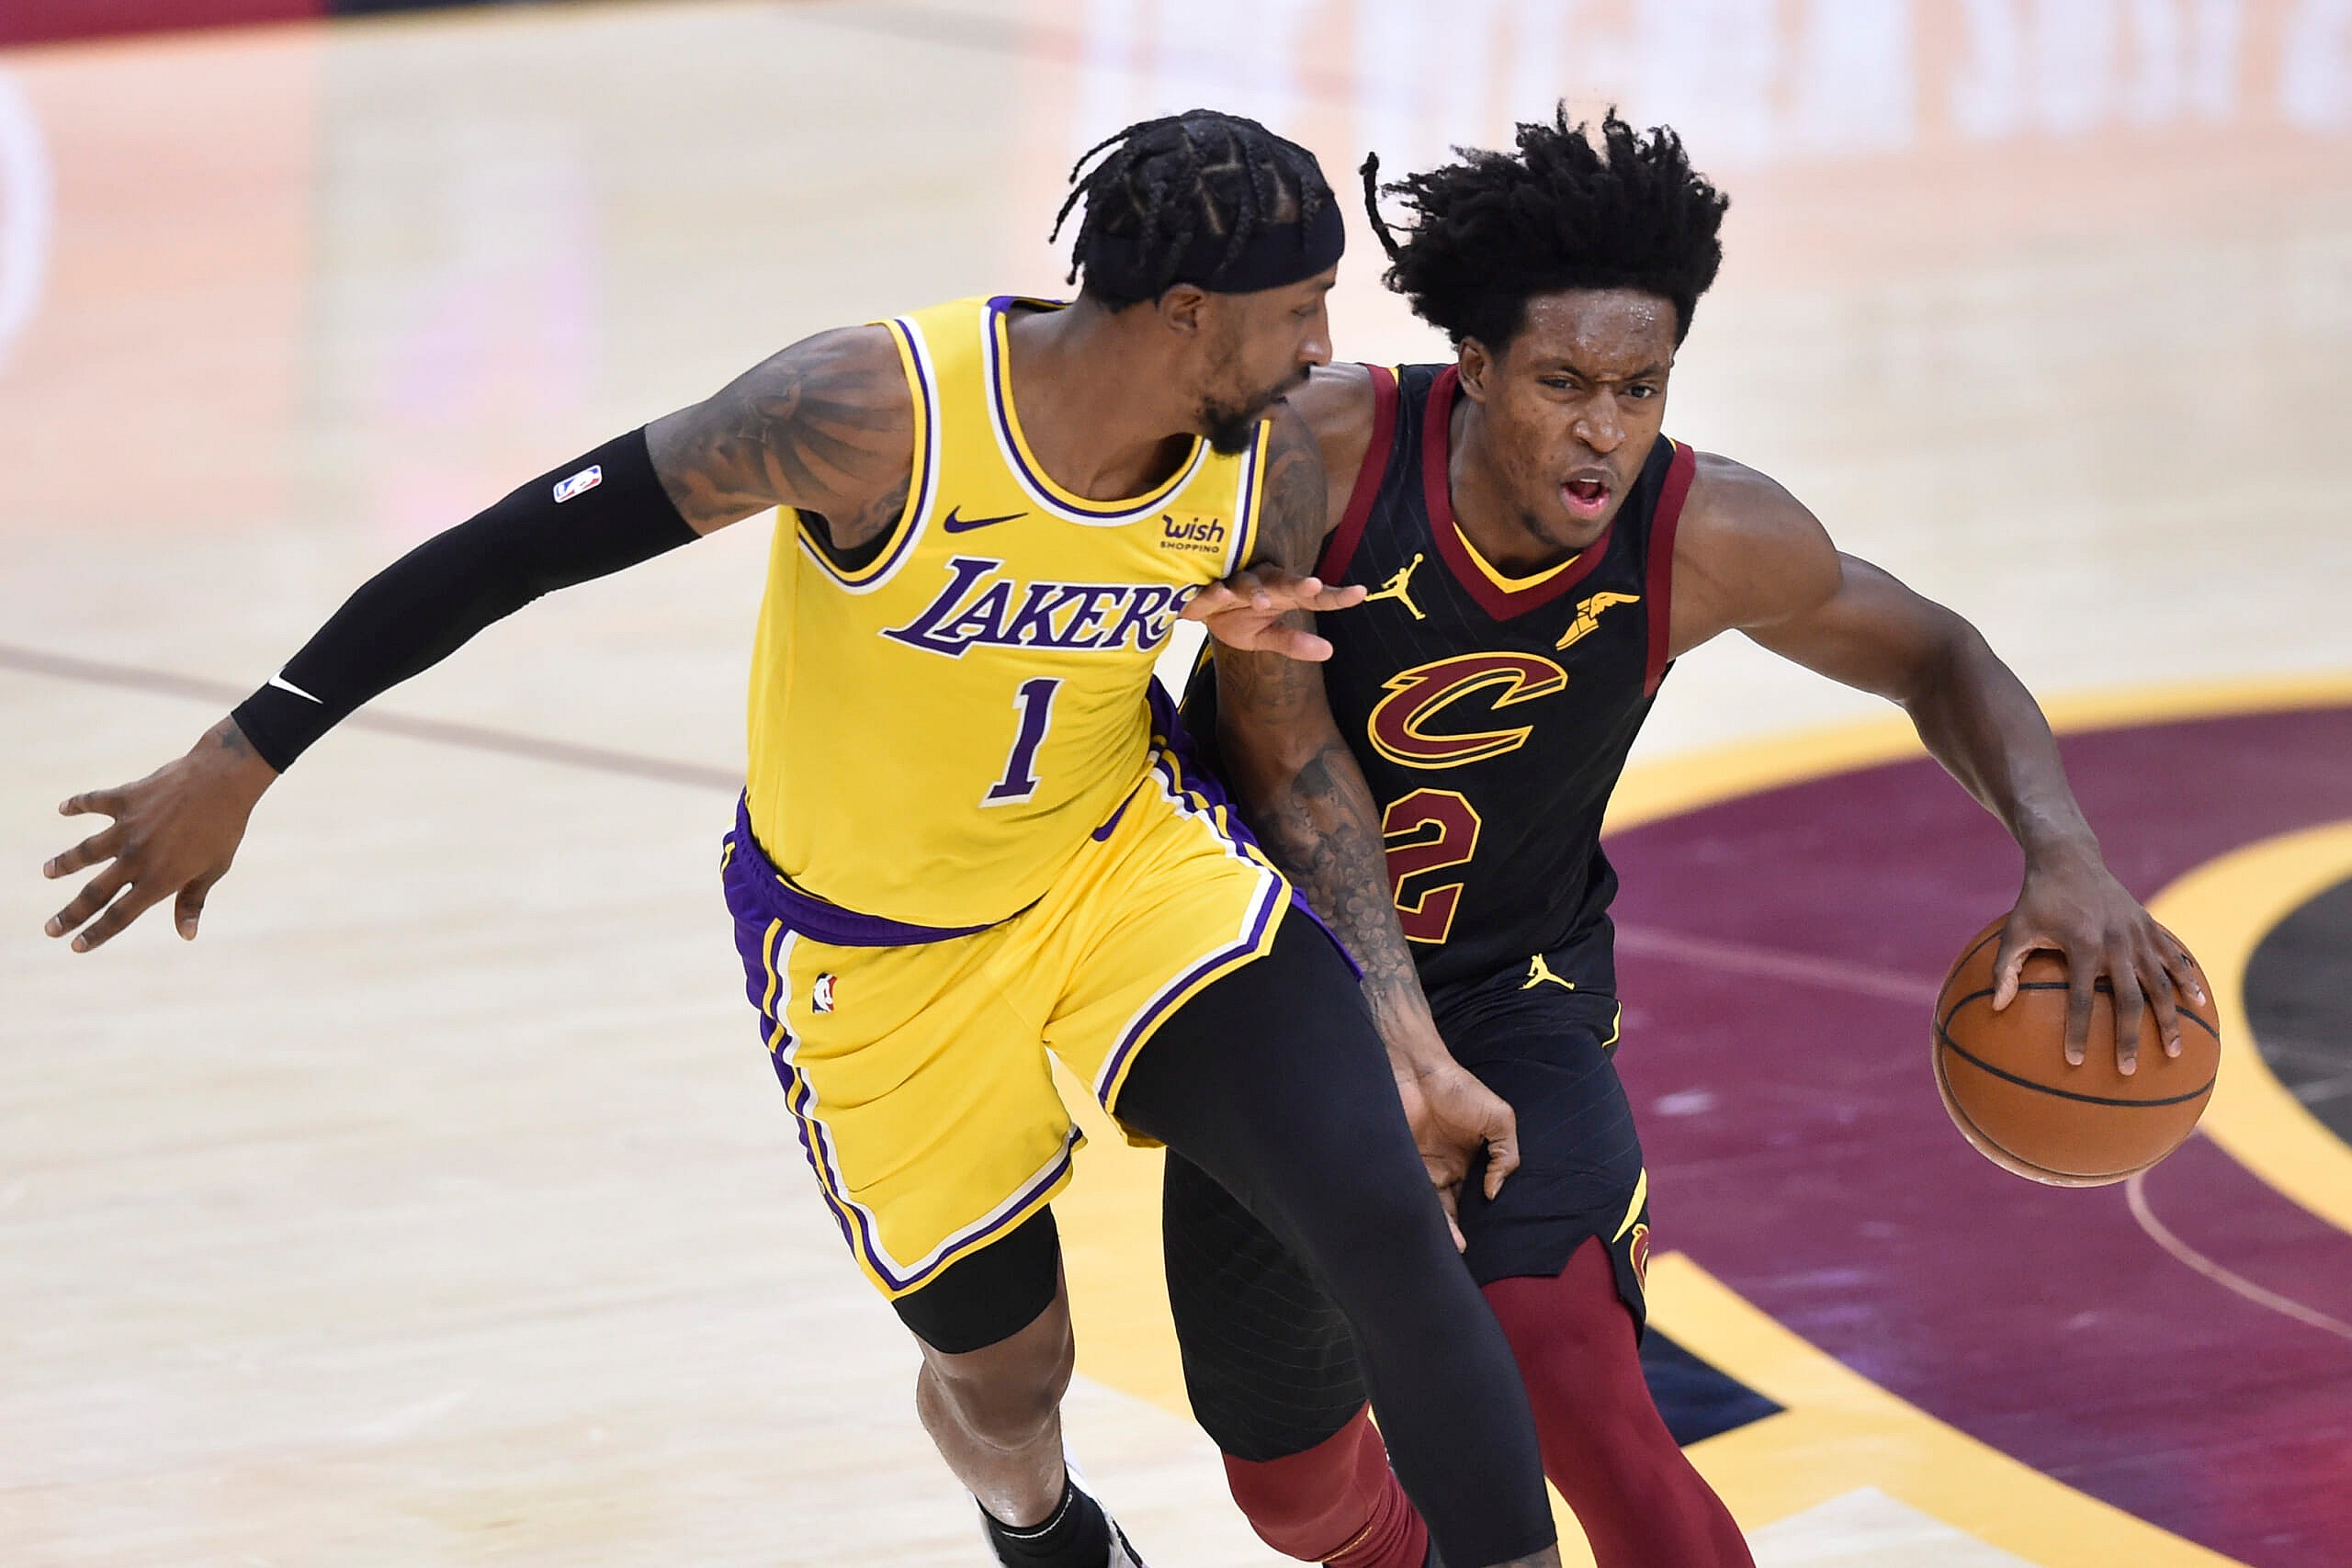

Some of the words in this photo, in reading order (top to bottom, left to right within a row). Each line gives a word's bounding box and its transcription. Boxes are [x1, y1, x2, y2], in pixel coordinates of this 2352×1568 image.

[1160, 540, 1220, 554] SHOPPING
[1161, 513, 1226, 544] wish
[979, 677, 1065, 808] 1
[1367, 651, 1568, 770] C
[1383, 787, 1482, 944] 2
